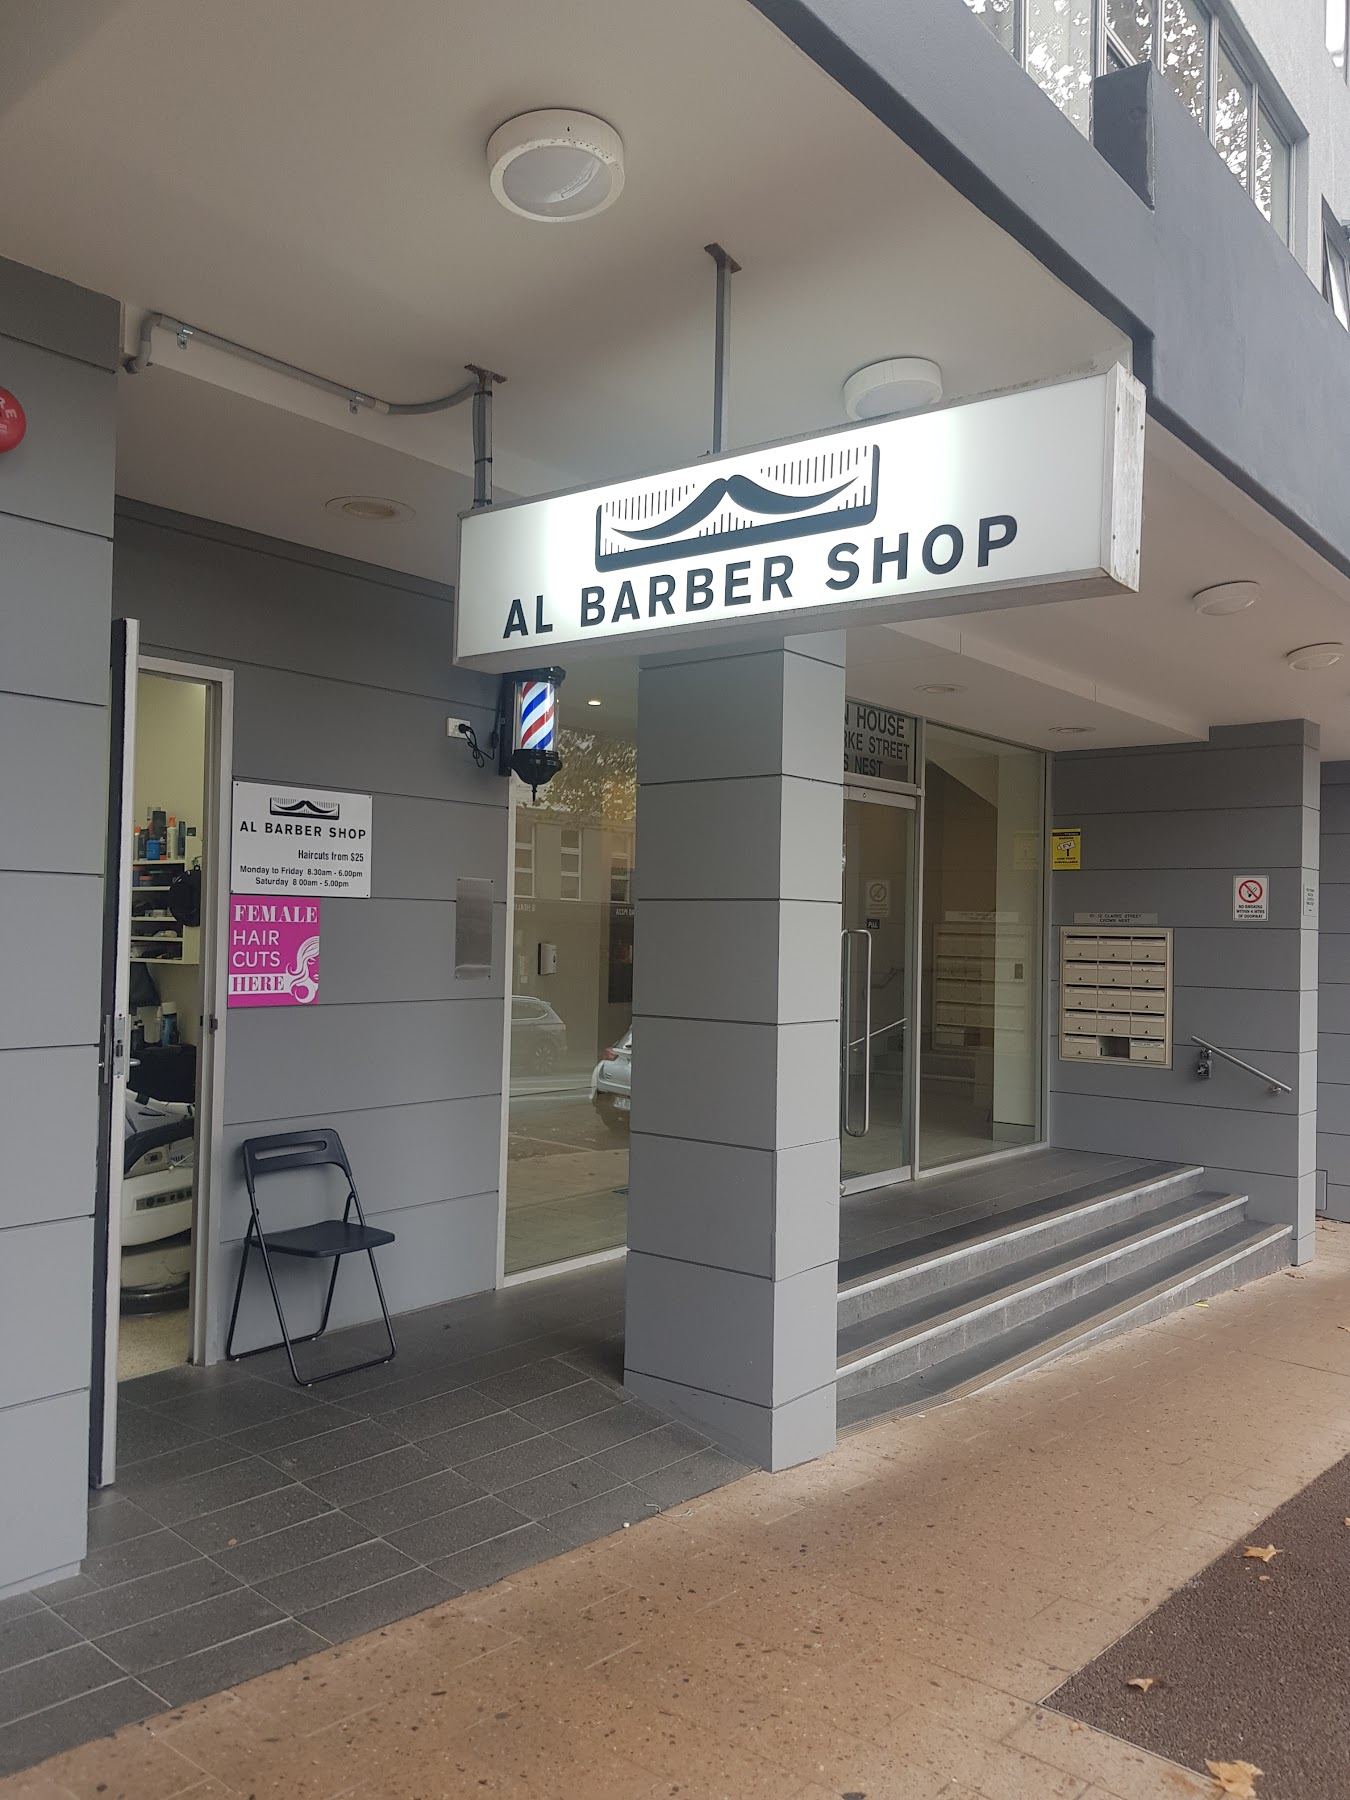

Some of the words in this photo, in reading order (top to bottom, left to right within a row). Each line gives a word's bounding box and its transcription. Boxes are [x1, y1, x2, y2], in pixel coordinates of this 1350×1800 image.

[503, 595, 553, 639] AL
[580, 555, 794, 628] BARBER
[825, 515, 1018, 591] SHOP
[857, 706, 905, 739] HOUSE
[869, 735, 910, 761] STREET
[855, 756, 882, 777] NEST
[240, 820, 257, 833] AL
[265, 822, 322, 837] BARBER
[329, 827, 366, 839] SHOP
[298, 849, 330, 861] Haircuts
[332, 851, 349, 862] from
[351, 852, 364, 862] $25
[240, 865, 270, 876] Monday
[272, 866, 280, 875] to
[281, 867, 304, 877] Friday
[307, 868, 332, 877] 8.30am
[338, 870, 363, 878] 6.00pm
[255, 877, 289, 887] Saturday
[292, 878, 318, 887] 800am
[324, 880, 349, 889] 5.00pm
[234, 904, 318, 923] FEMALE
[233, 930, 280, 946] HAIR
[232, 951, 281, 968] CUTS
[232, 976, 284, 993] HERE
